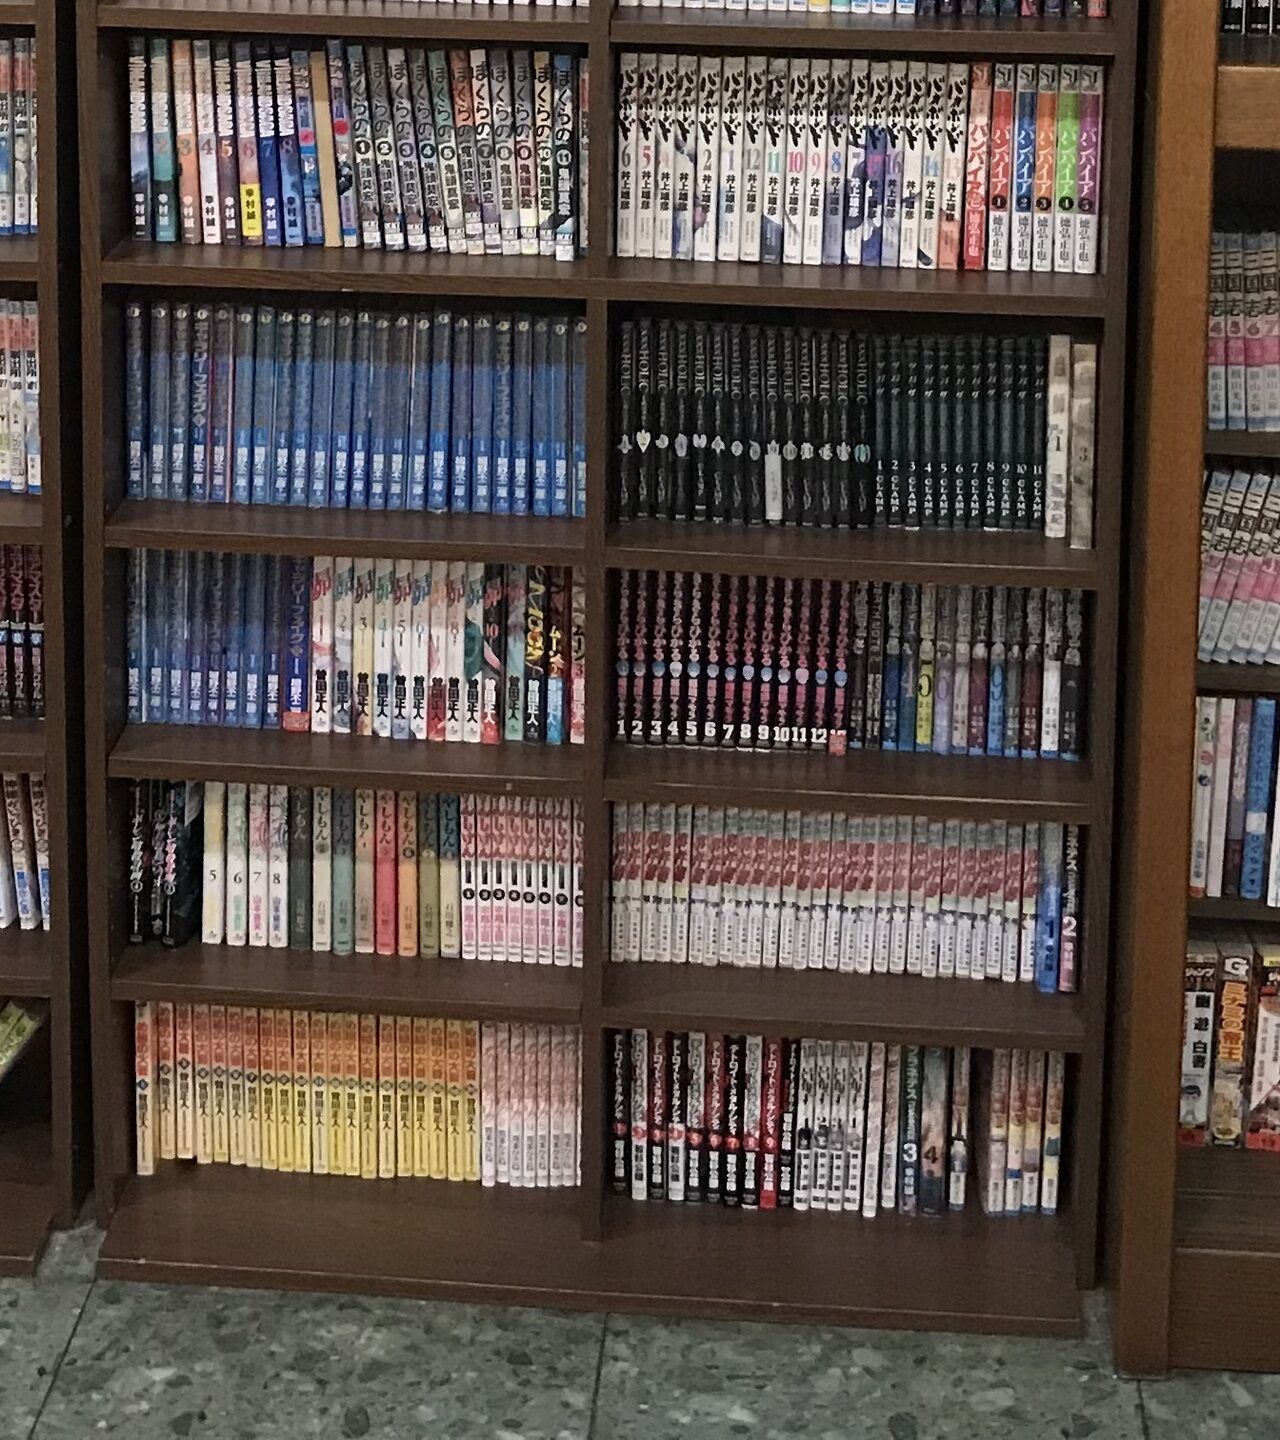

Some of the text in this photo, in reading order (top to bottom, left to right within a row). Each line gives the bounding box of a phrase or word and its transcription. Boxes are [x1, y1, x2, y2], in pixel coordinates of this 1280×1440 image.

[622, 144, 631, 167] 6
[788, 152, 804, 173] 10
[992, 125, 1010, 194] バンパイア
[1017, 126, 1034, 195] バンパイア
[1036, 130, 1053, 195] バンパイア
[620, 171, 630, 210] 井上雄彦
[641, 171, 651, 209] 井上雄彦
[767, 176, 778, 215] 井上雄彦
[924, 478, 933, 516] CLAMP
[986, 477, 995, 514] CLAMP
